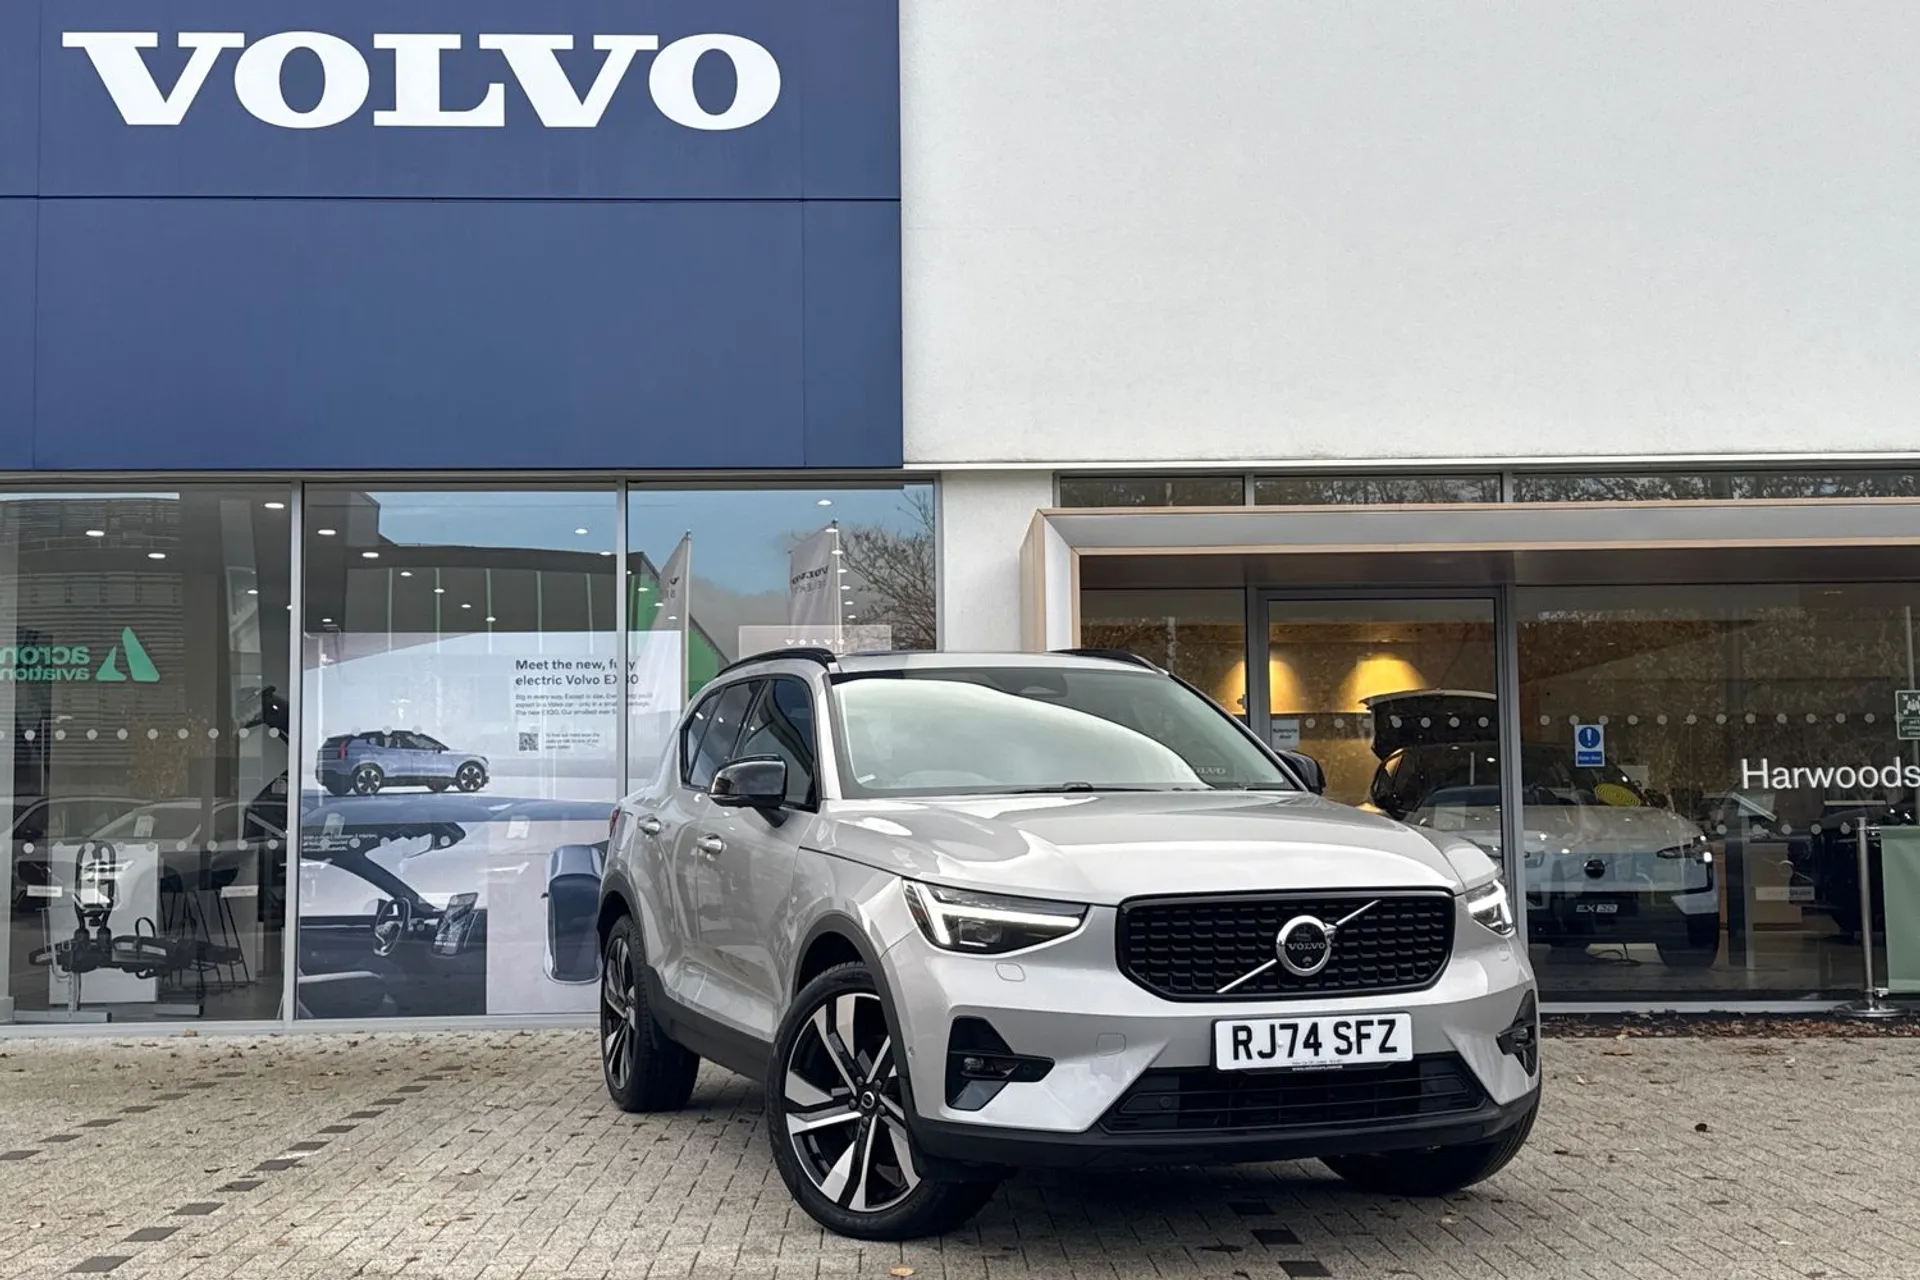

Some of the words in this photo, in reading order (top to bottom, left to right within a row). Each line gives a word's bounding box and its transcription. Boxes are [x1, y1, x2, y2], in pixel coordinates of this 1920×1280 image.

[62, 31, 781, 130] VOLVO
[785, 638, 845, 646] VOLVO
[515, 659, 549, 670] Meet
[552, 658, 573, 670] the
[576, 661, 606, 671] new,
[515, 674, 563, 686] electric
[565, 674, 601, 686] Volvo
[1741, 756, 1920, 789] Harwoods
[1287, 942, 1325, 951] VOLVO
[1232, 1022, 1322, 1060] RJ74
[1333, 1019, 1398, 1056] SFZ
